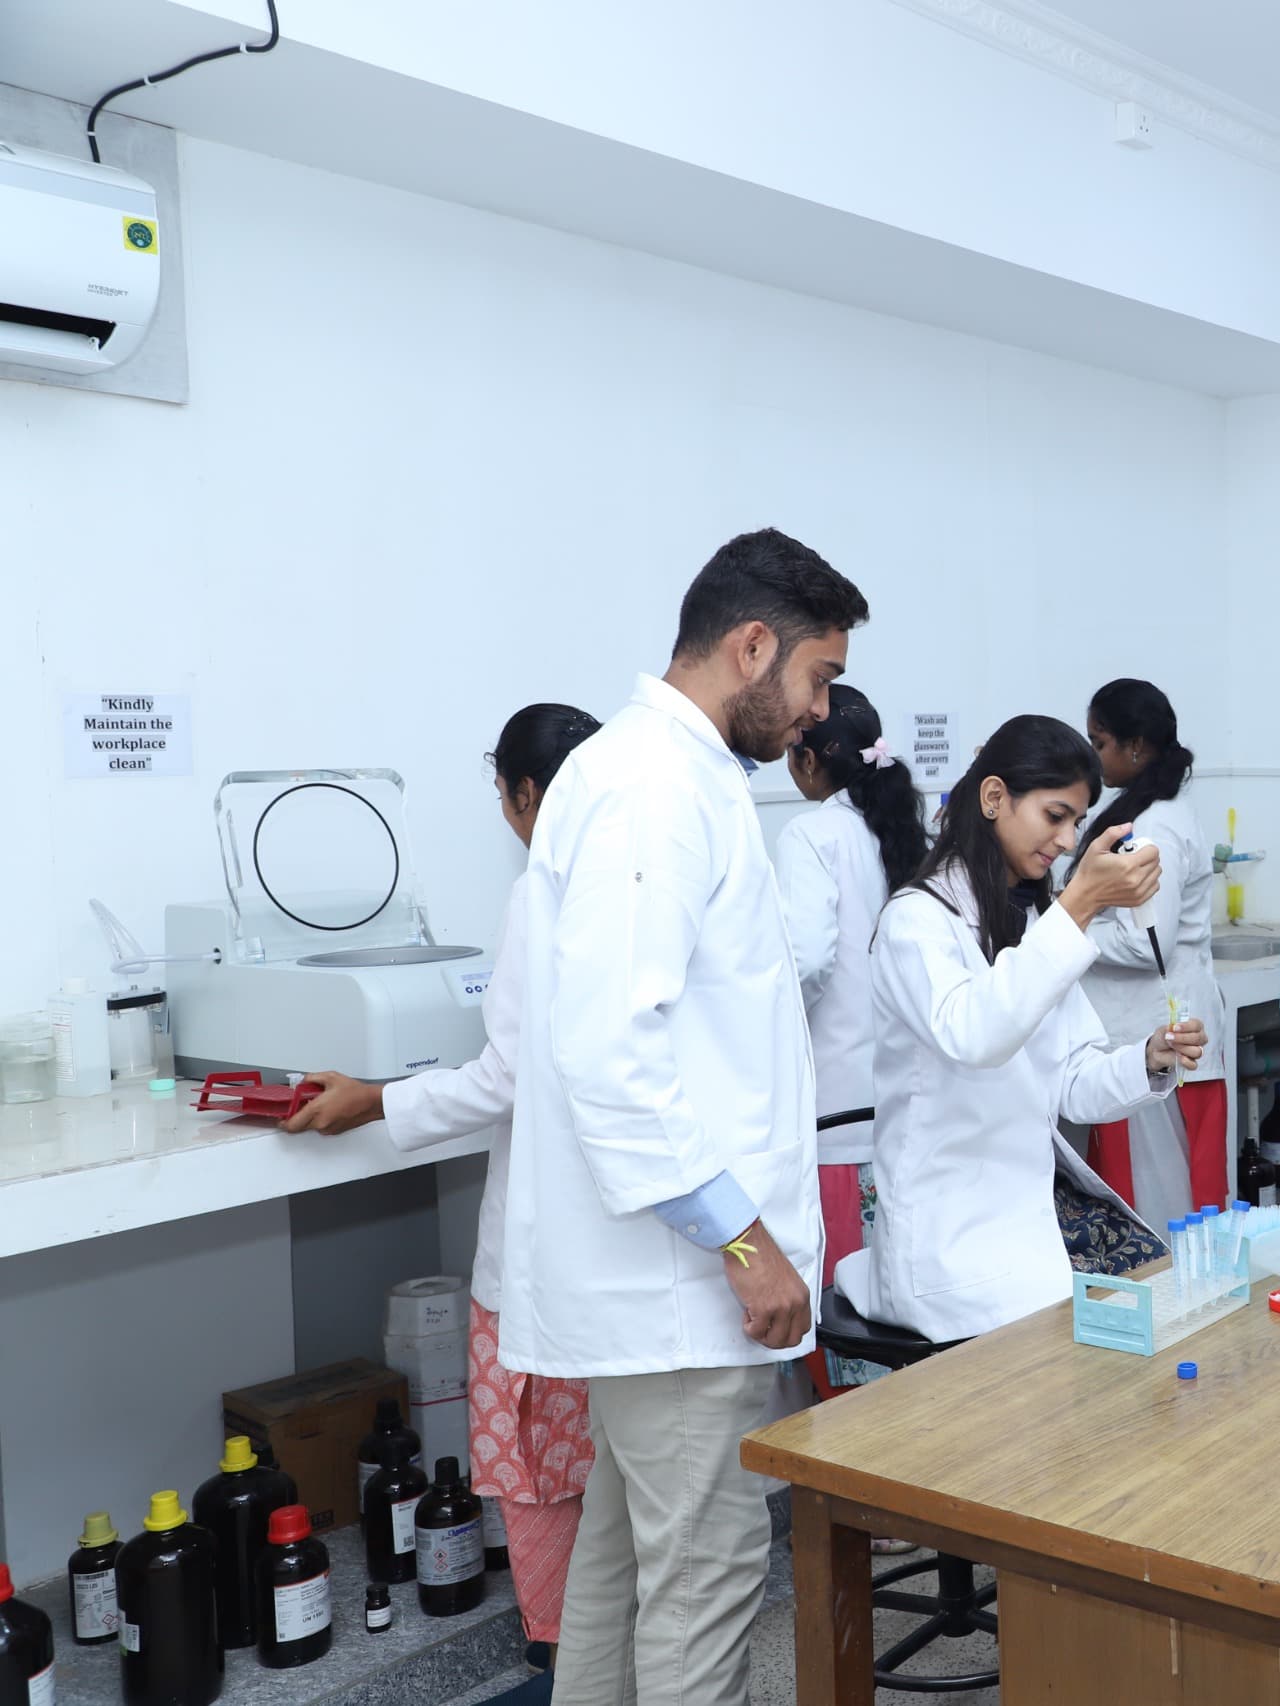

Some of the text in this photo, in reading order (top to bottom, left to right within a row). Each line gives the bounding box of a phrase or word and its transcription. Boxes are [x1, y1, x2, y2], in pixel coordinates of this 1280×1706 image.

[101, 698, 154, 712] "Kindly
[84, 718, 173, 730] Maintain the
[936, 714, 947, 725] and
[918, 729, 945, 739] keep the
[92, 737, 166, 752] workplace
[109, 757, 152, 769] clean"
[915, 755, 931, 764] after
